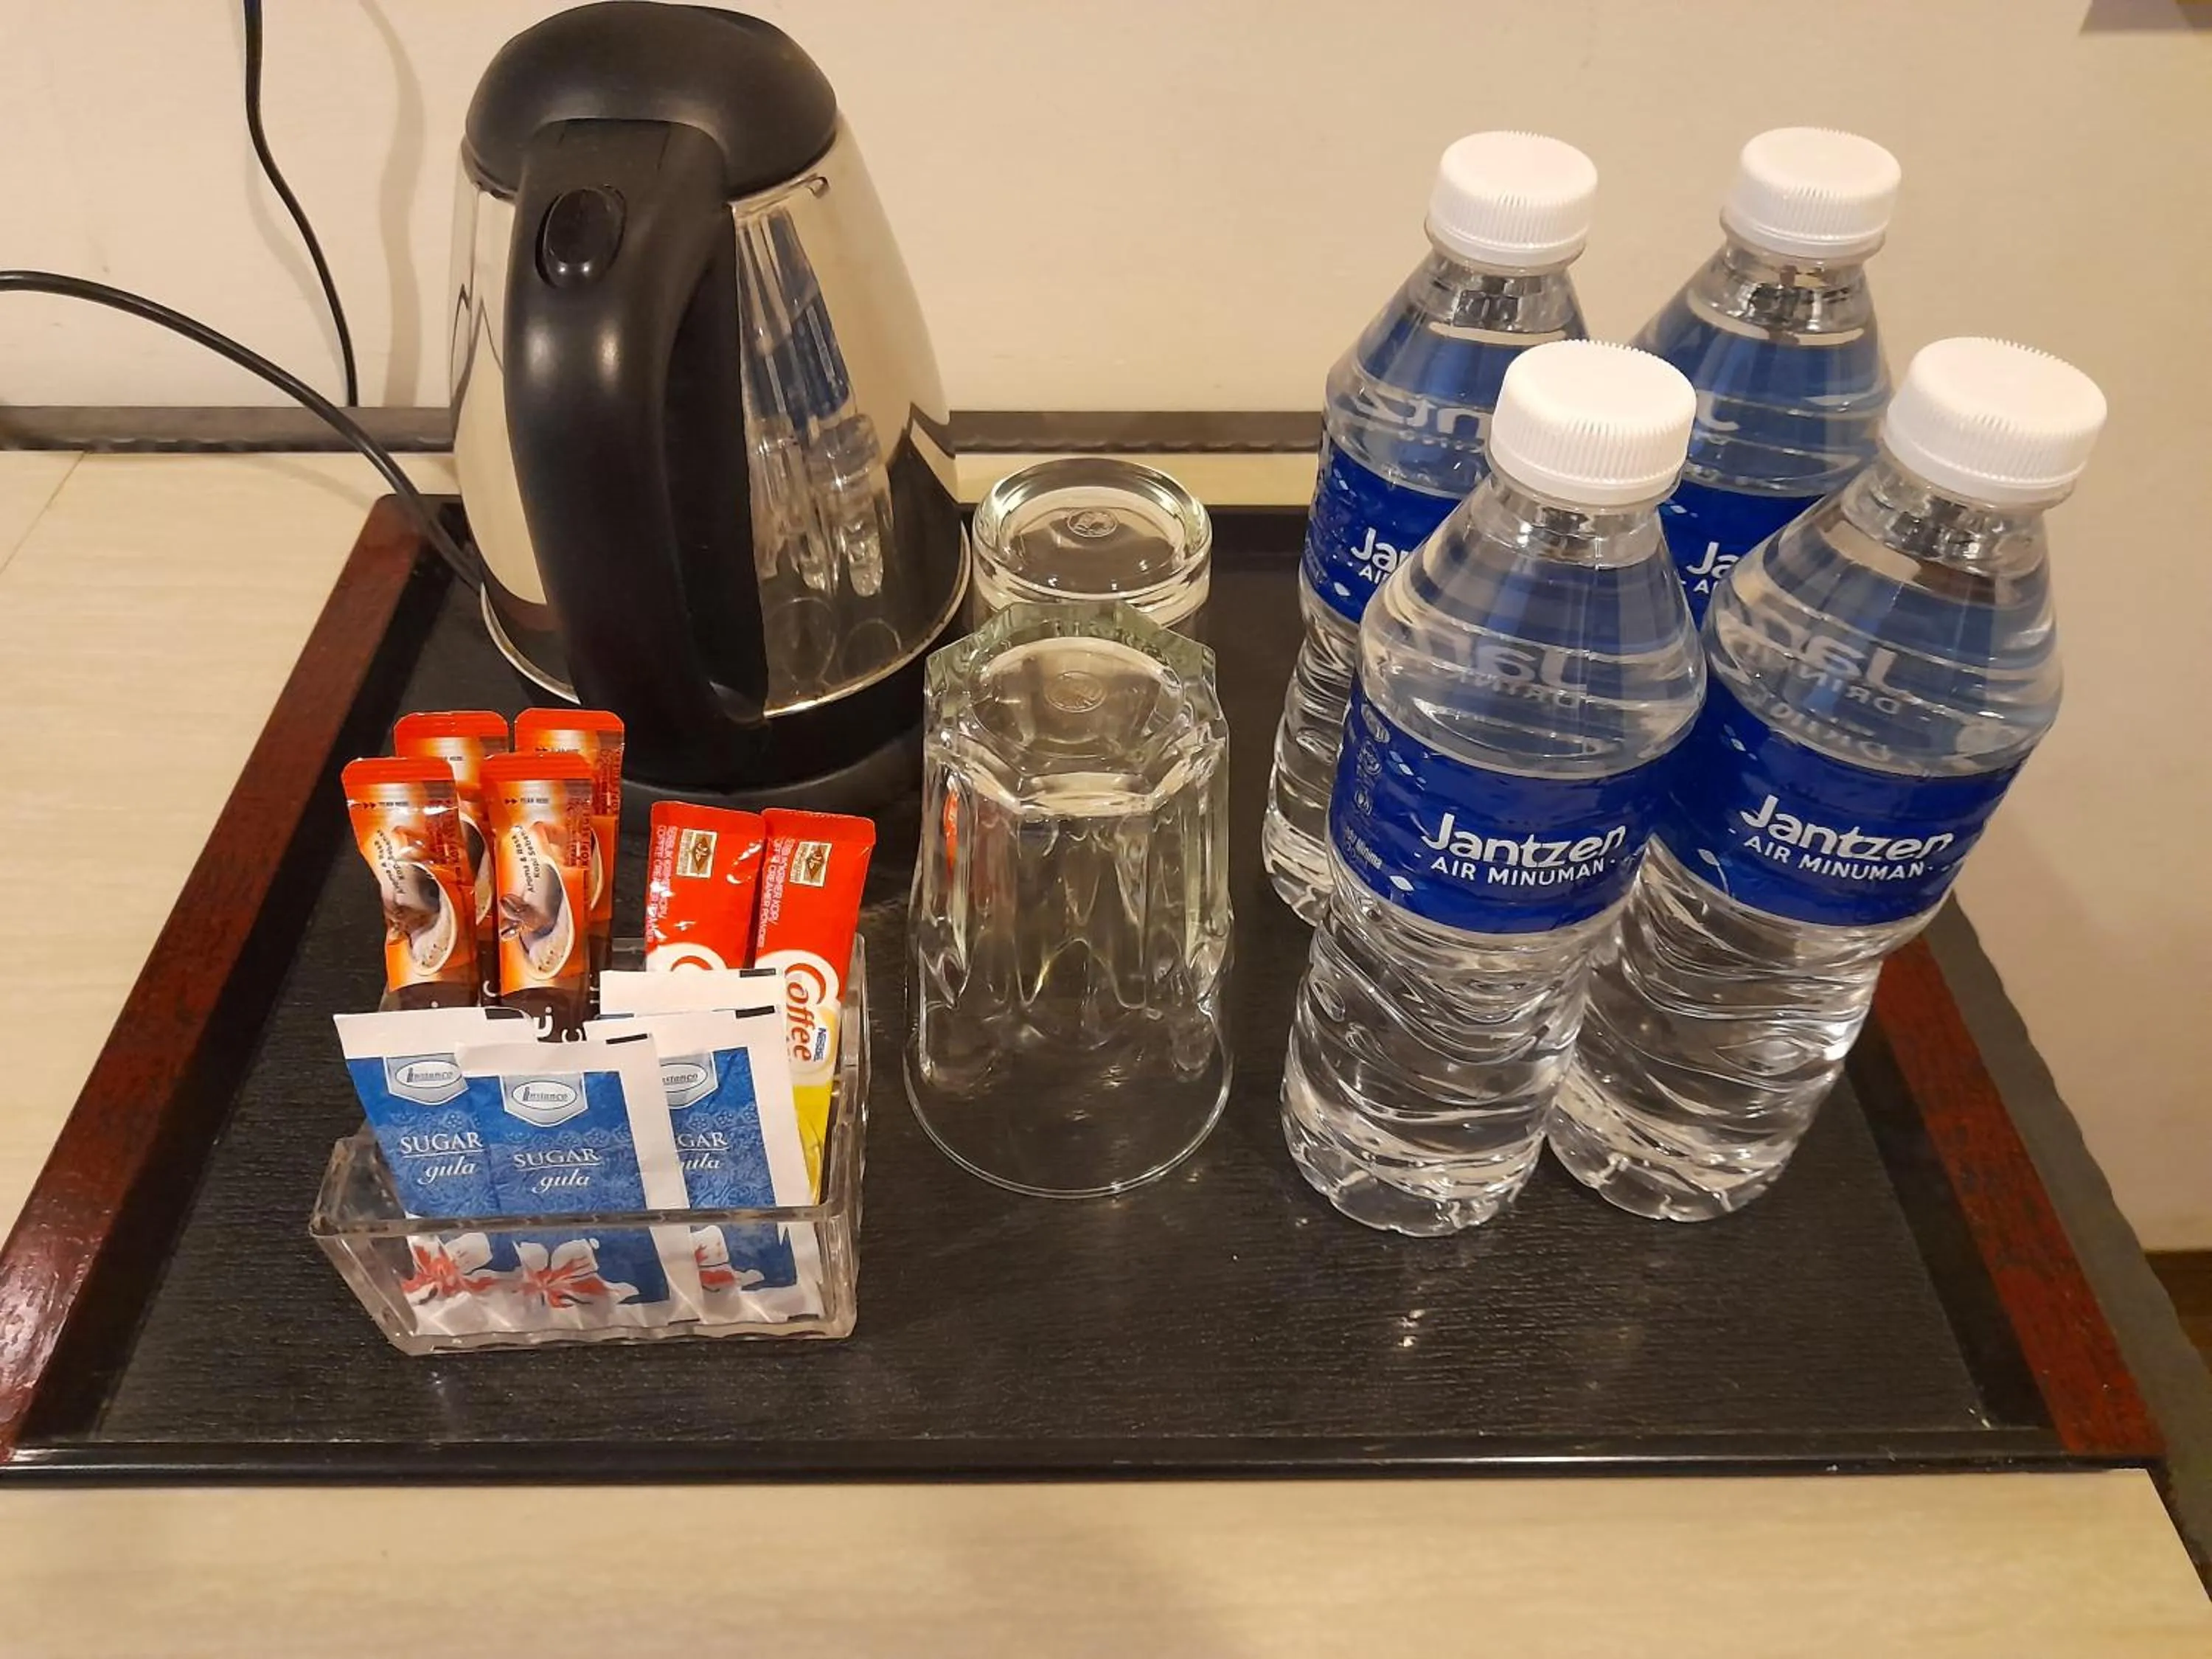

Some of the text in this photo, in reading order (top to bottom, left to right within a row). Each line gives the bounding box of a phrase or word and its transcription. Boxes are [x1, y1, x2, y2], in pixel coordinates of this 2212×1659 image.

[1422, 813, 1626, 868] Jantzen
[1740, 794, 1954, 861] Jantzen
[531, 858, 540, 878] Kopi
[1744, 835, 1924, 880] AIR MINUMAN
[524, 865, 535, 893] Aroma
[1431, 857, 1604, 886] AIR MINUMAN
[400, 1132, 483, 1155] SUGAR
[677, 1131, 728, 1149] GAR
[417, 1156, 478, 1184] gula
[514, 1148, 602, 1168] SUGAR
[681, 1152, 720, 1170] ula
[532, 1168, 591, 1193] gula
